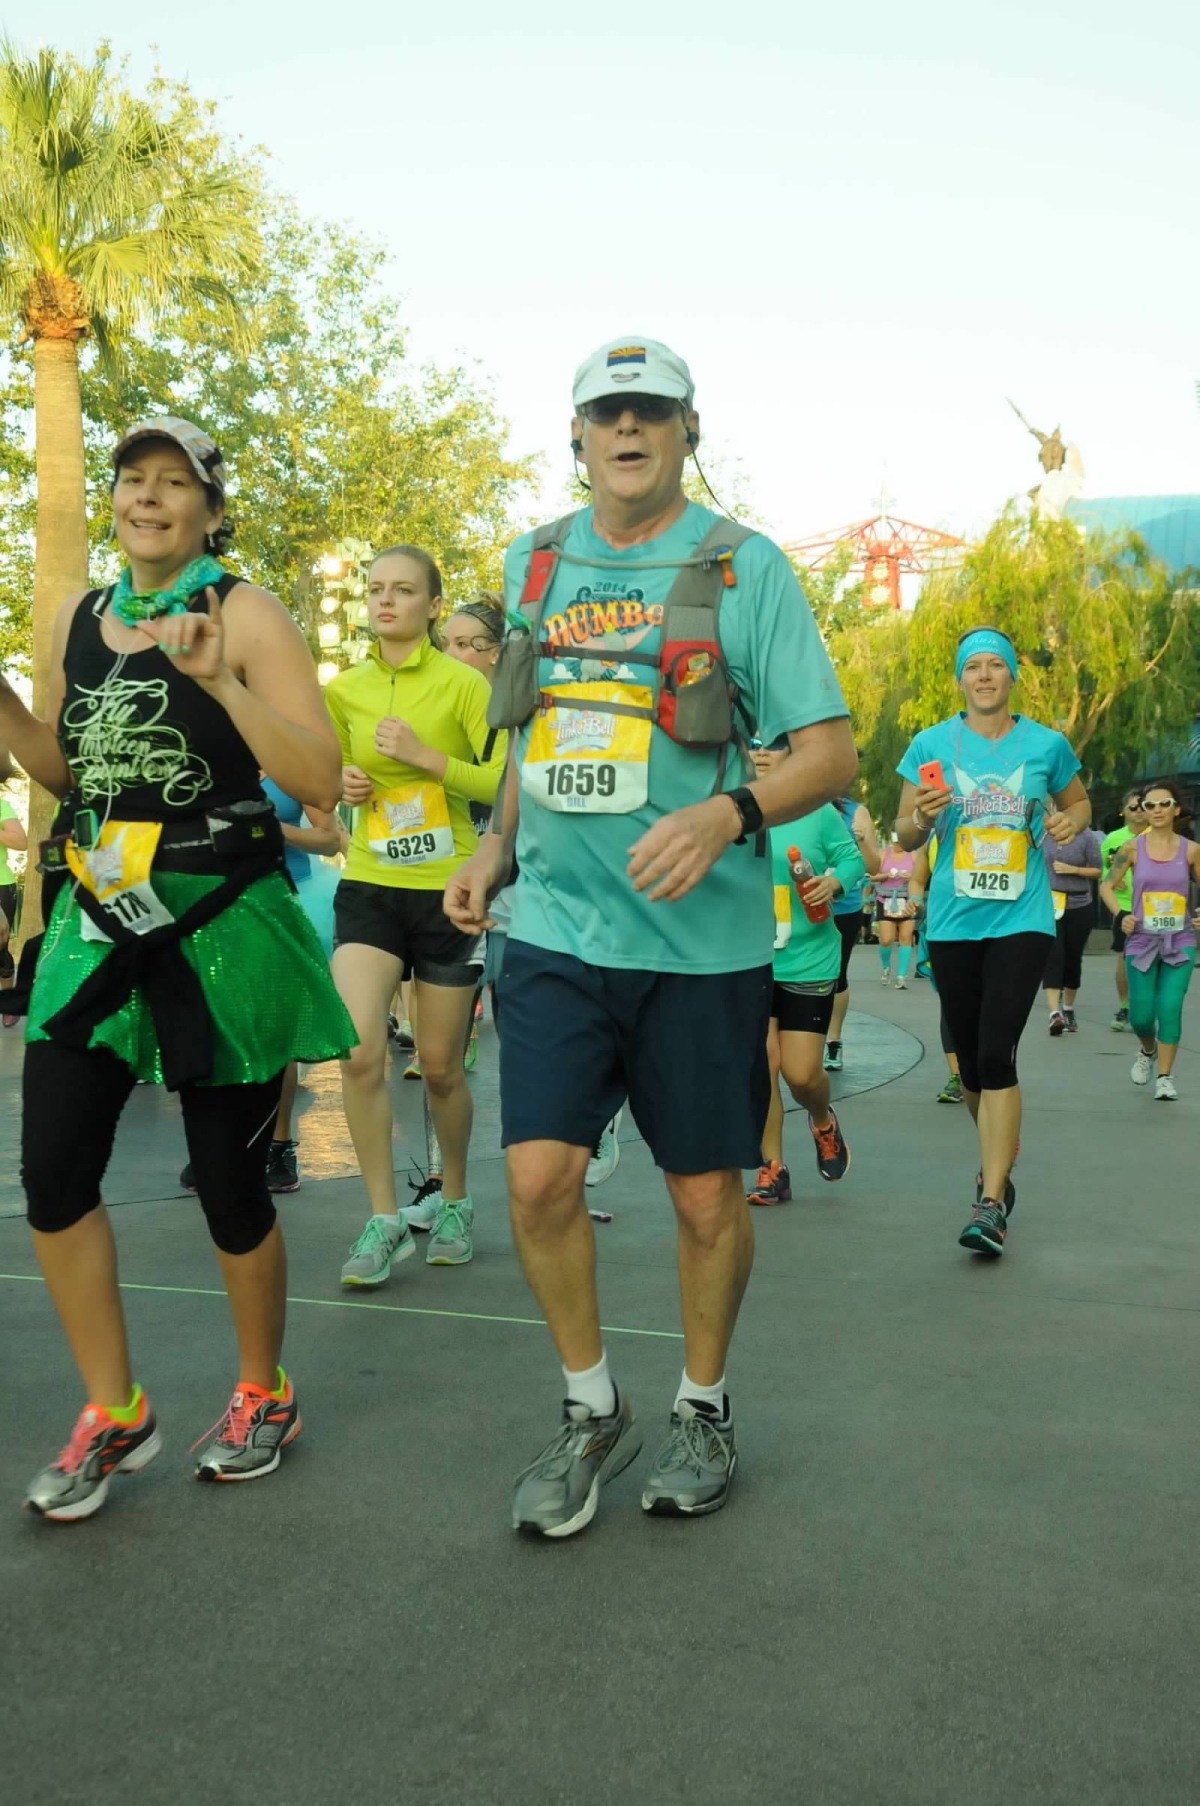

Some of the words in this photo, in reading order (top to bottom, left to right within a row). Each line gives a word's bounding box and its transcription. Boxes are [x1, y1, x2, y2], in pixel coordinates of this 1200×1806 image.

[593, 581, 628, 593] 2014
[545, 763, 616, 797] 1659
[386, 833, 436, 859] 6329
[793, 864, 802, 875] G
[969, 872, 1009, 891] 7426
[1152, 916, 1176, 927] 5160
